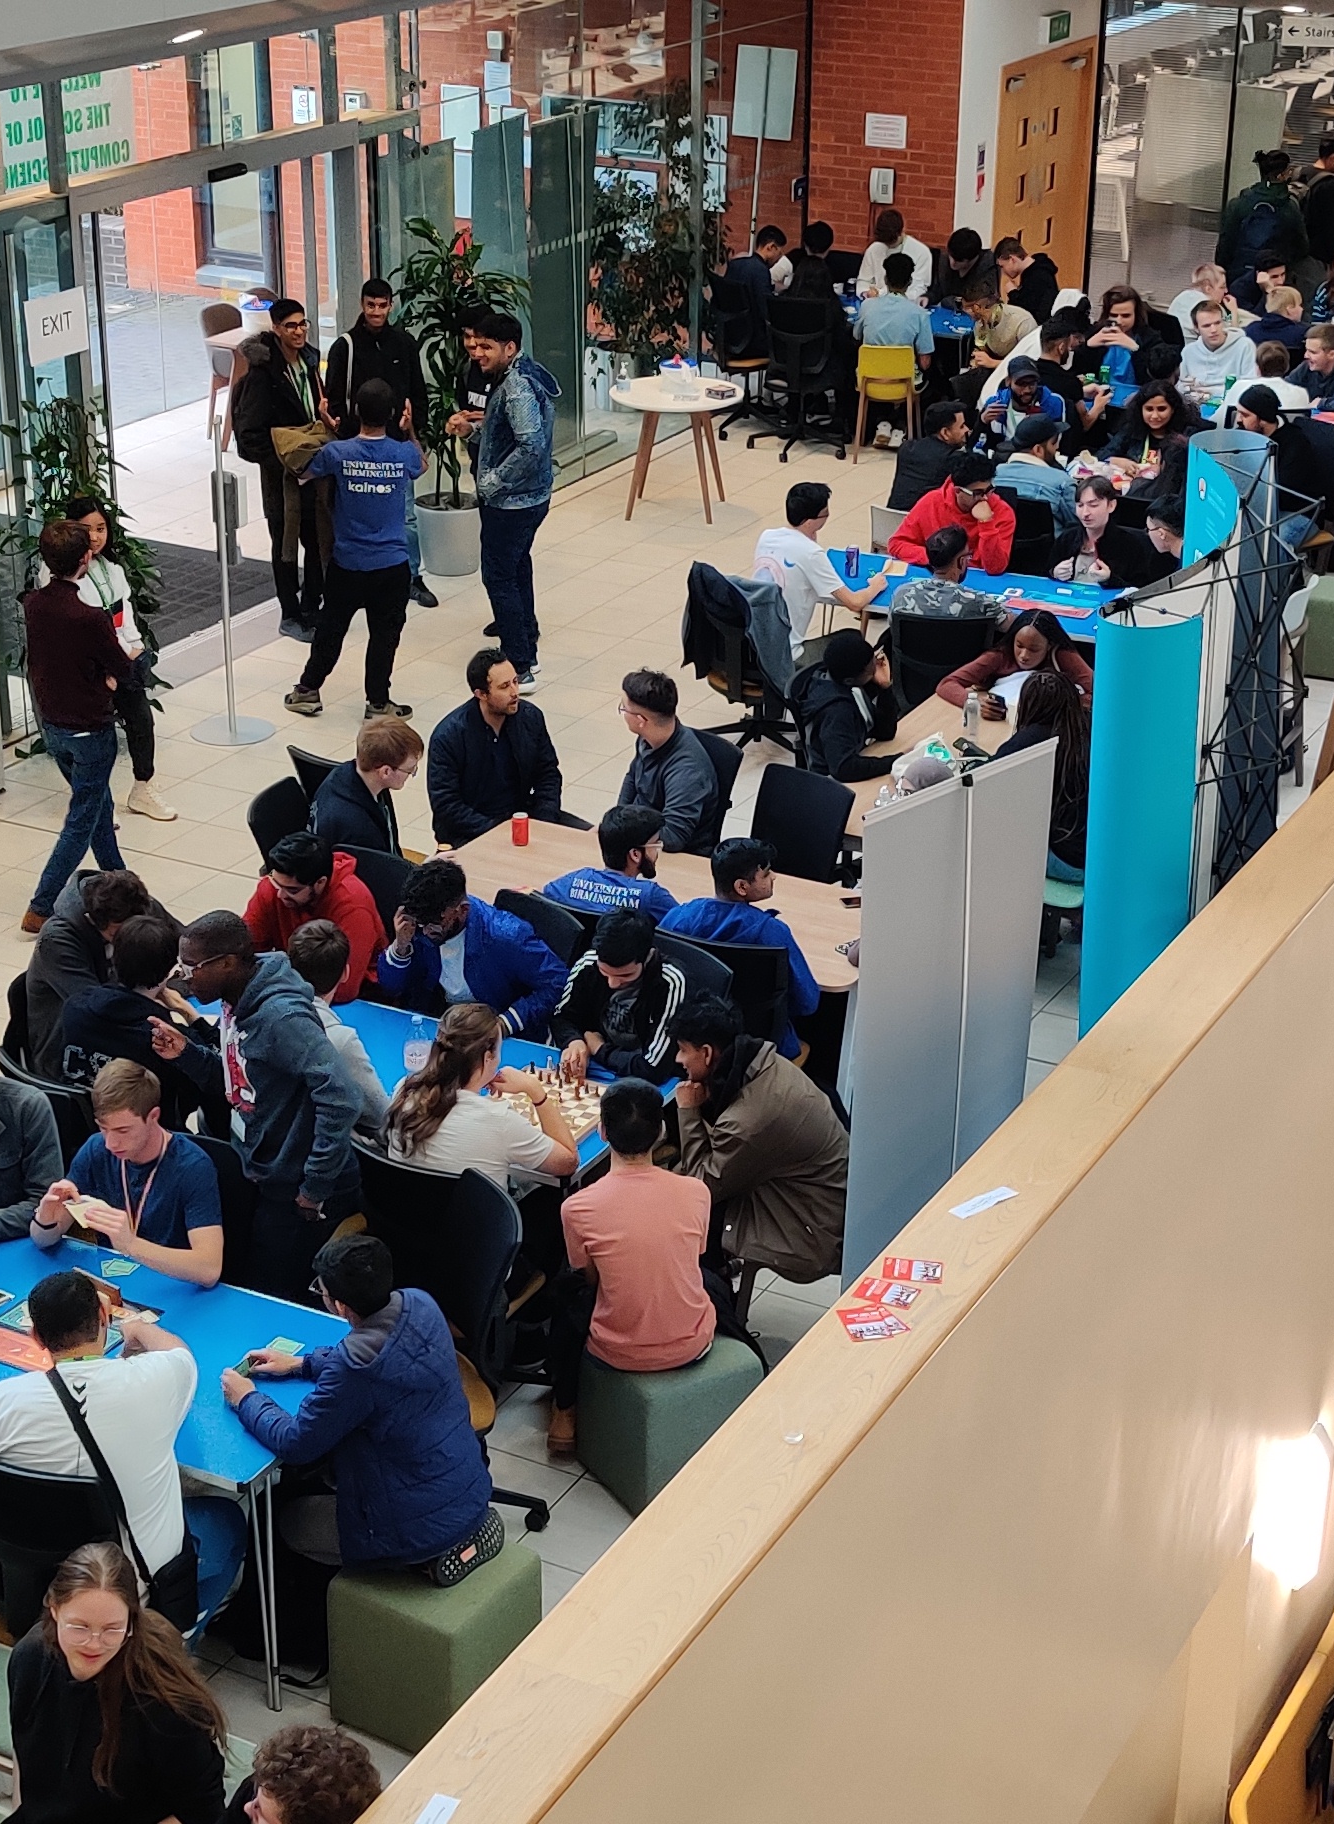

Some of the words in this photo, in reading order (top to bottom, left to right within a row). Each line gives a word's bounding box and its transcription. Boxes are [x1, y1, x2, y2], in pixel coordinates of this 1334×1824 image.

[42, 310, 73, 337] EXIT
[347, 479, 392, 494] kainos
[571, 877, 629, 897] UNIVERSITY
[569, 887, 641, 909] BIRMINGHAM
